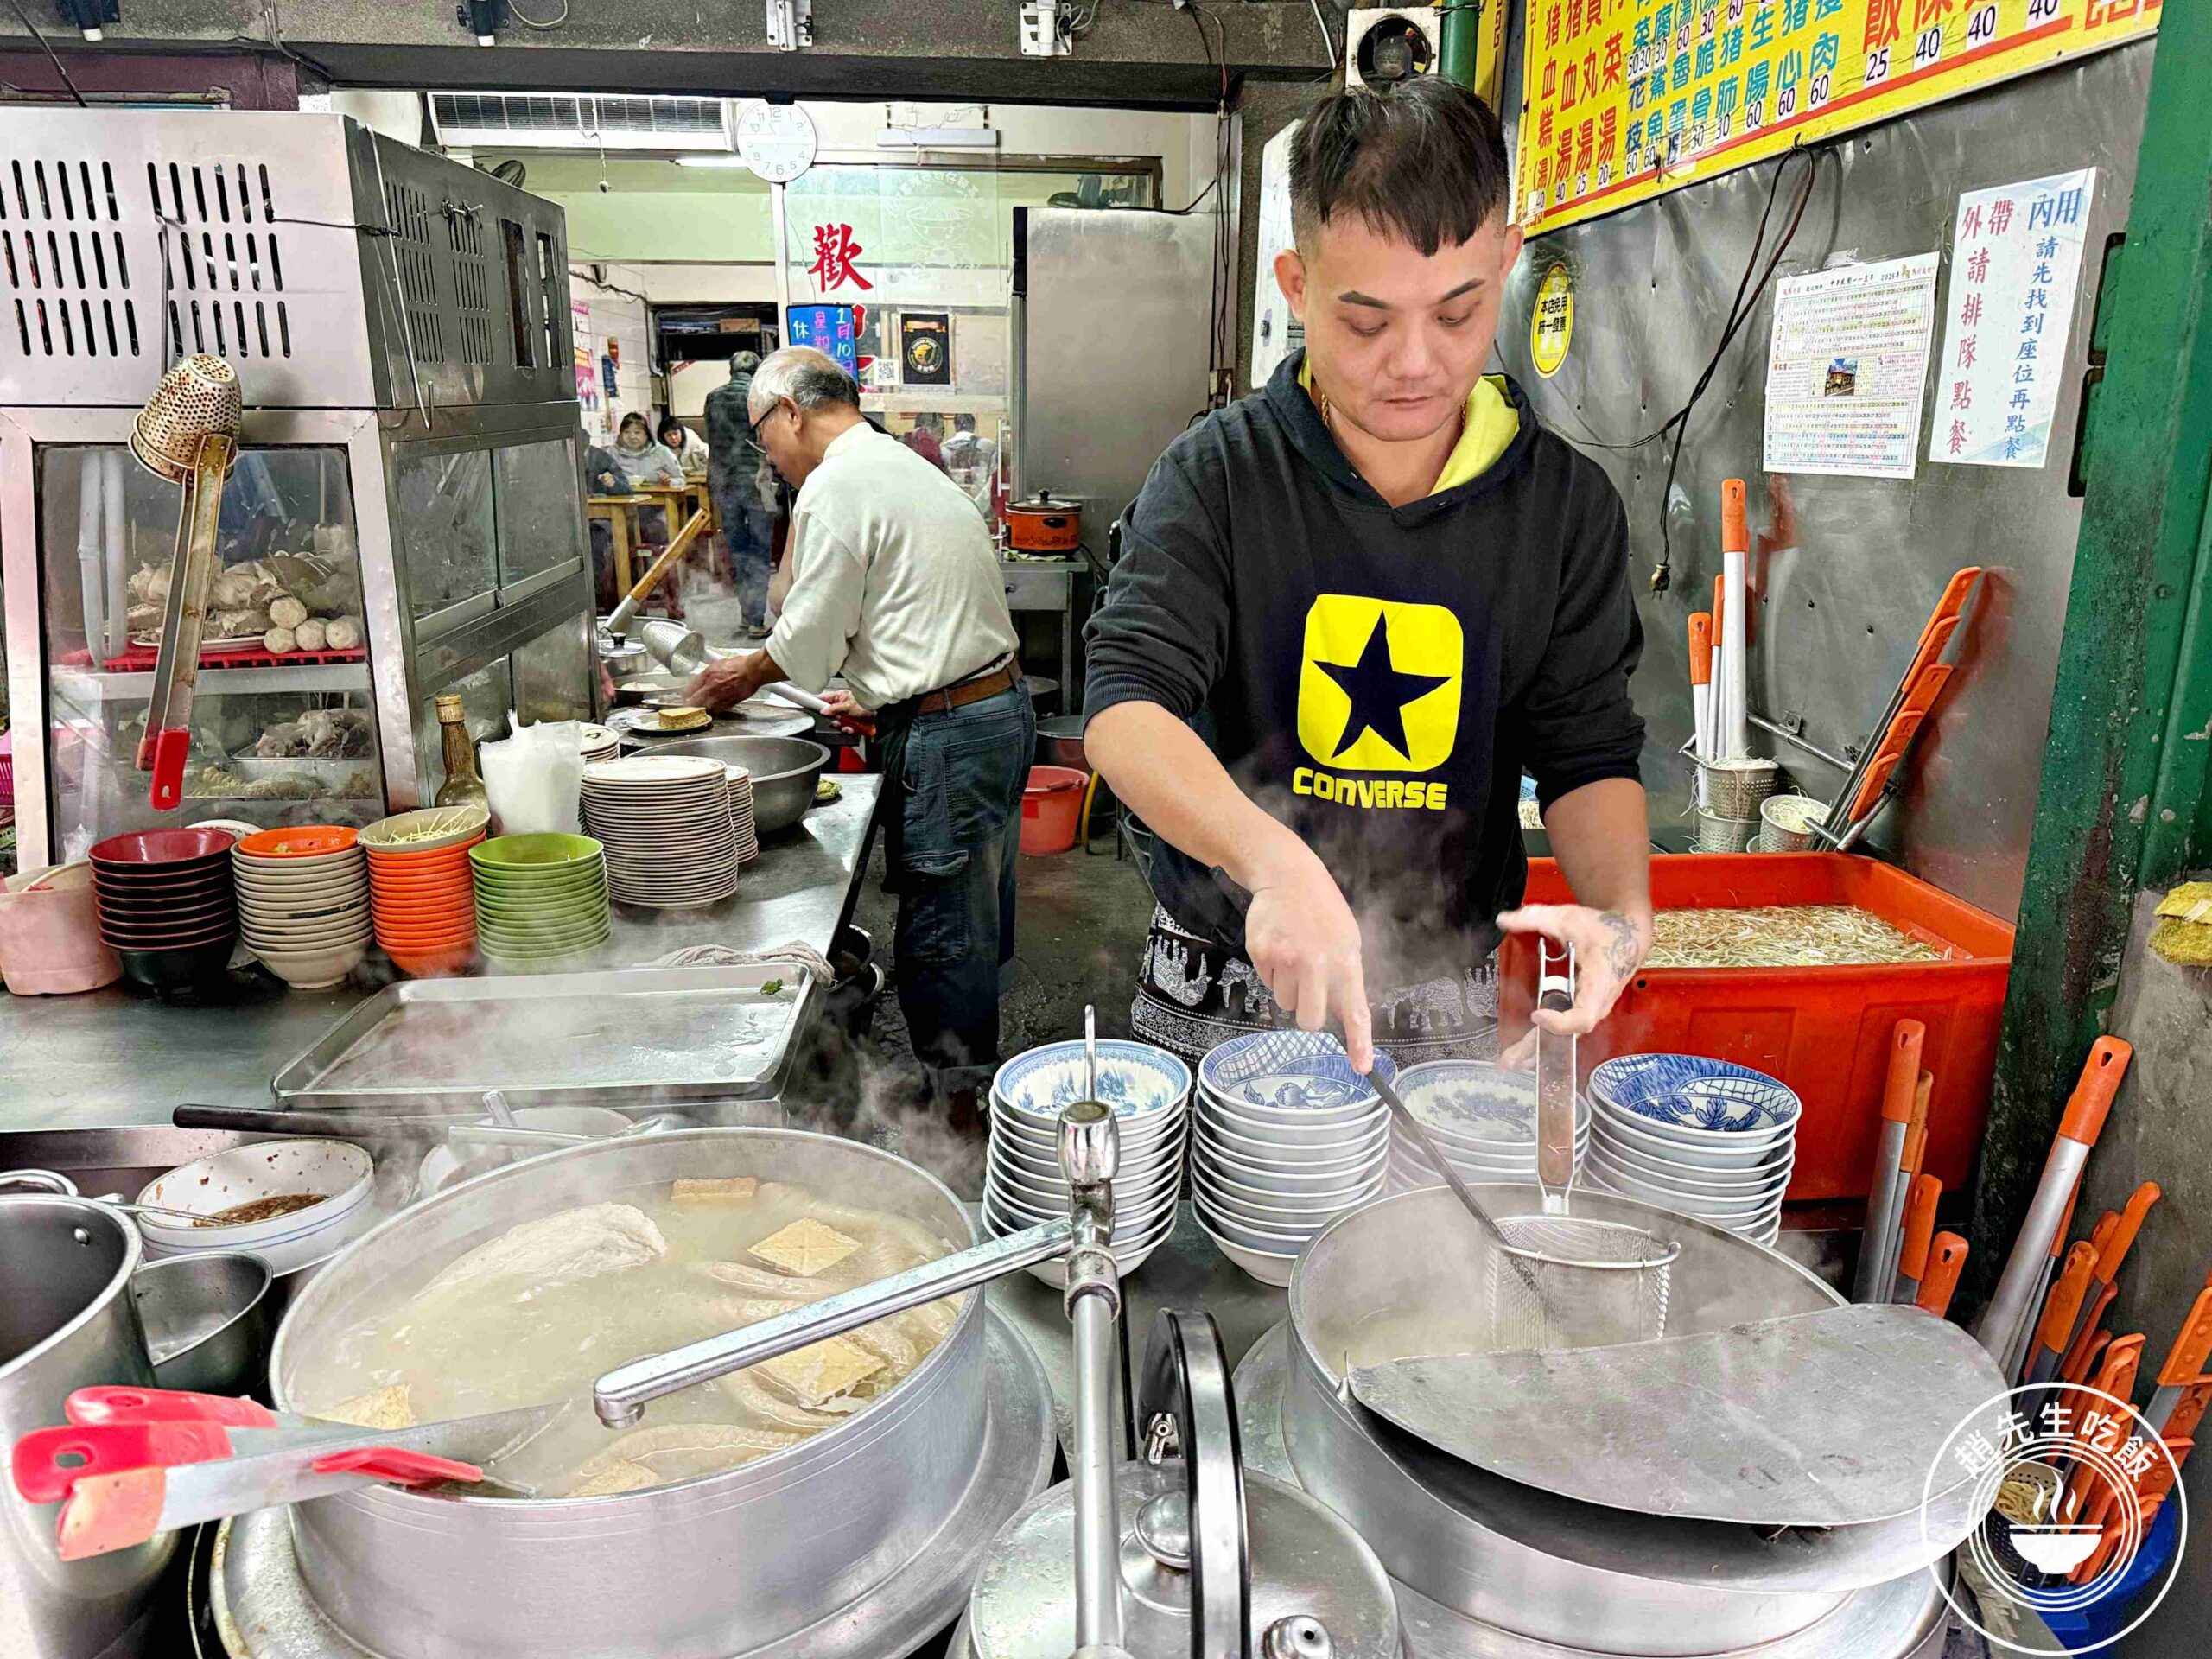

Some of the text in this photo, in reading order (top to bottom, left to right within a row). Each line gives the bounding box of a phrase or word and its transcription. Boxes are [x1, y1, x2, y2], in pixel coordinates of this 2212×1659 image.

[1676, 24, 1690, 50] 60
[1700, 10, 1715, 36] 30
[1967, 6, 1997, 41] 40
[1654, 38, 1668, 64] 30
[1745, 7, 1776, 106] 生腸
[1915, 29, 1941, 60] 40
[1692, 36, 1717, 123] 脆骨
[1866, 48, 1889, 81] 25
[1597, 0, 1624, 186] 菜湯 20
[1777, 86, 1796, 117] 60
[1810, 74, 1830, 105] 60
[768, 106, 782, 118] 12
[1624, 77, 1647, 175] 花枝 60
[1716, 113, 1732, 141] 30
[1746, 100, 1764, 129] 60
[1691, 124, 1706, 149] 30
[753, 152, 761, 162] 8
[775, 164, 785, 175] 6
[789, 160, 798, 170] 5
[1643, 145, 1656, 168] 60
[1576, 174, 1587, 195] 25
[1961, 200, 2014, 241] 外帶
[2027, 186, 2082, 232] 內用
[1948, 247, 1991, 455] 請排隊點餐
[2004, 237, 2060, 461] 請先找到座位再點餐
[1292, 766, 1448, 810] CONVERSE
